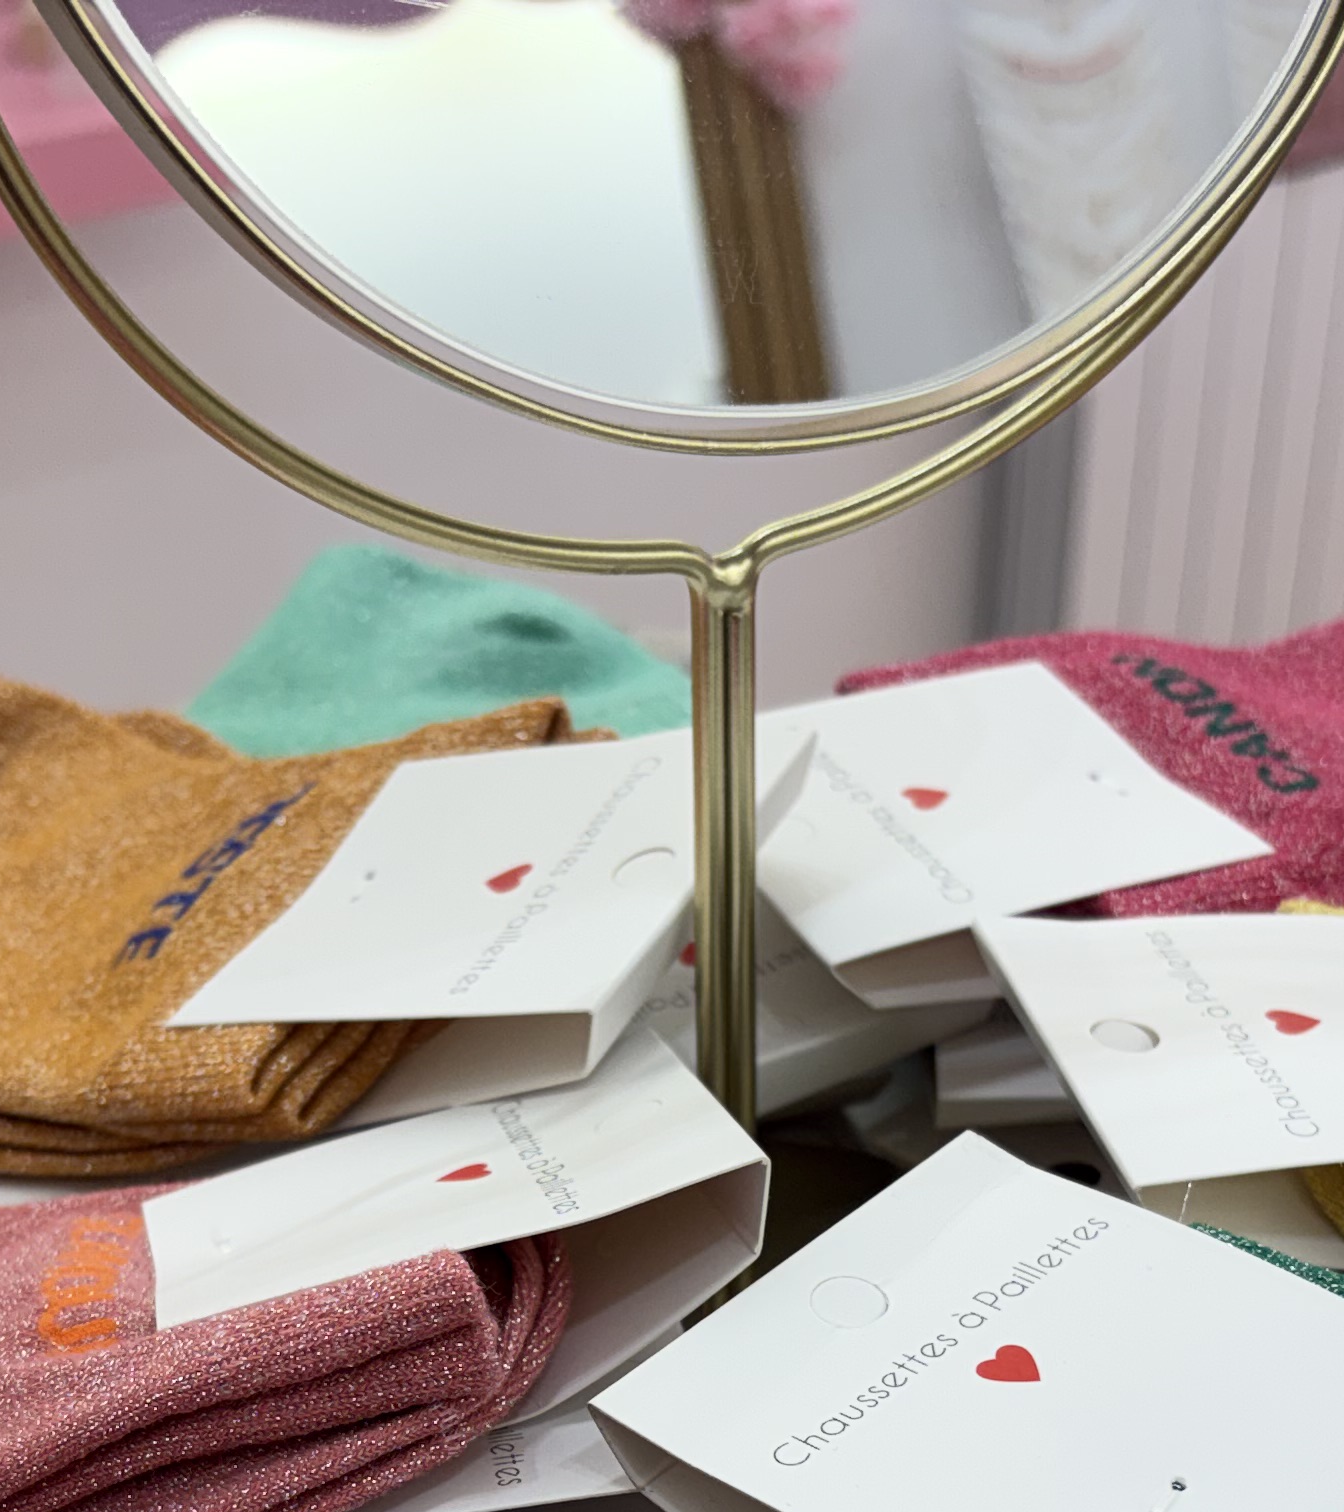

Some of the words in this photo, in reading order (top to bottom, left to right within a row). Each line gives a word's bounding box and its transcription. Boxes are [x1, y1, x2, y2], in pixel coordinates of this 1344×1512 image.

[1145, 929, 1217, 1003] Paillettes
[1201, 1005, 1232, 1019] à
[1220, 1022, 1320, 1138] Chaussettes
[531, 1163, 579, 1215] Paillettes
[772, 1333, 959, 1467] Chaussettes
[951, 1311, 989, 1329] à
[971, 1217, 1110, 1312] Paillettes
